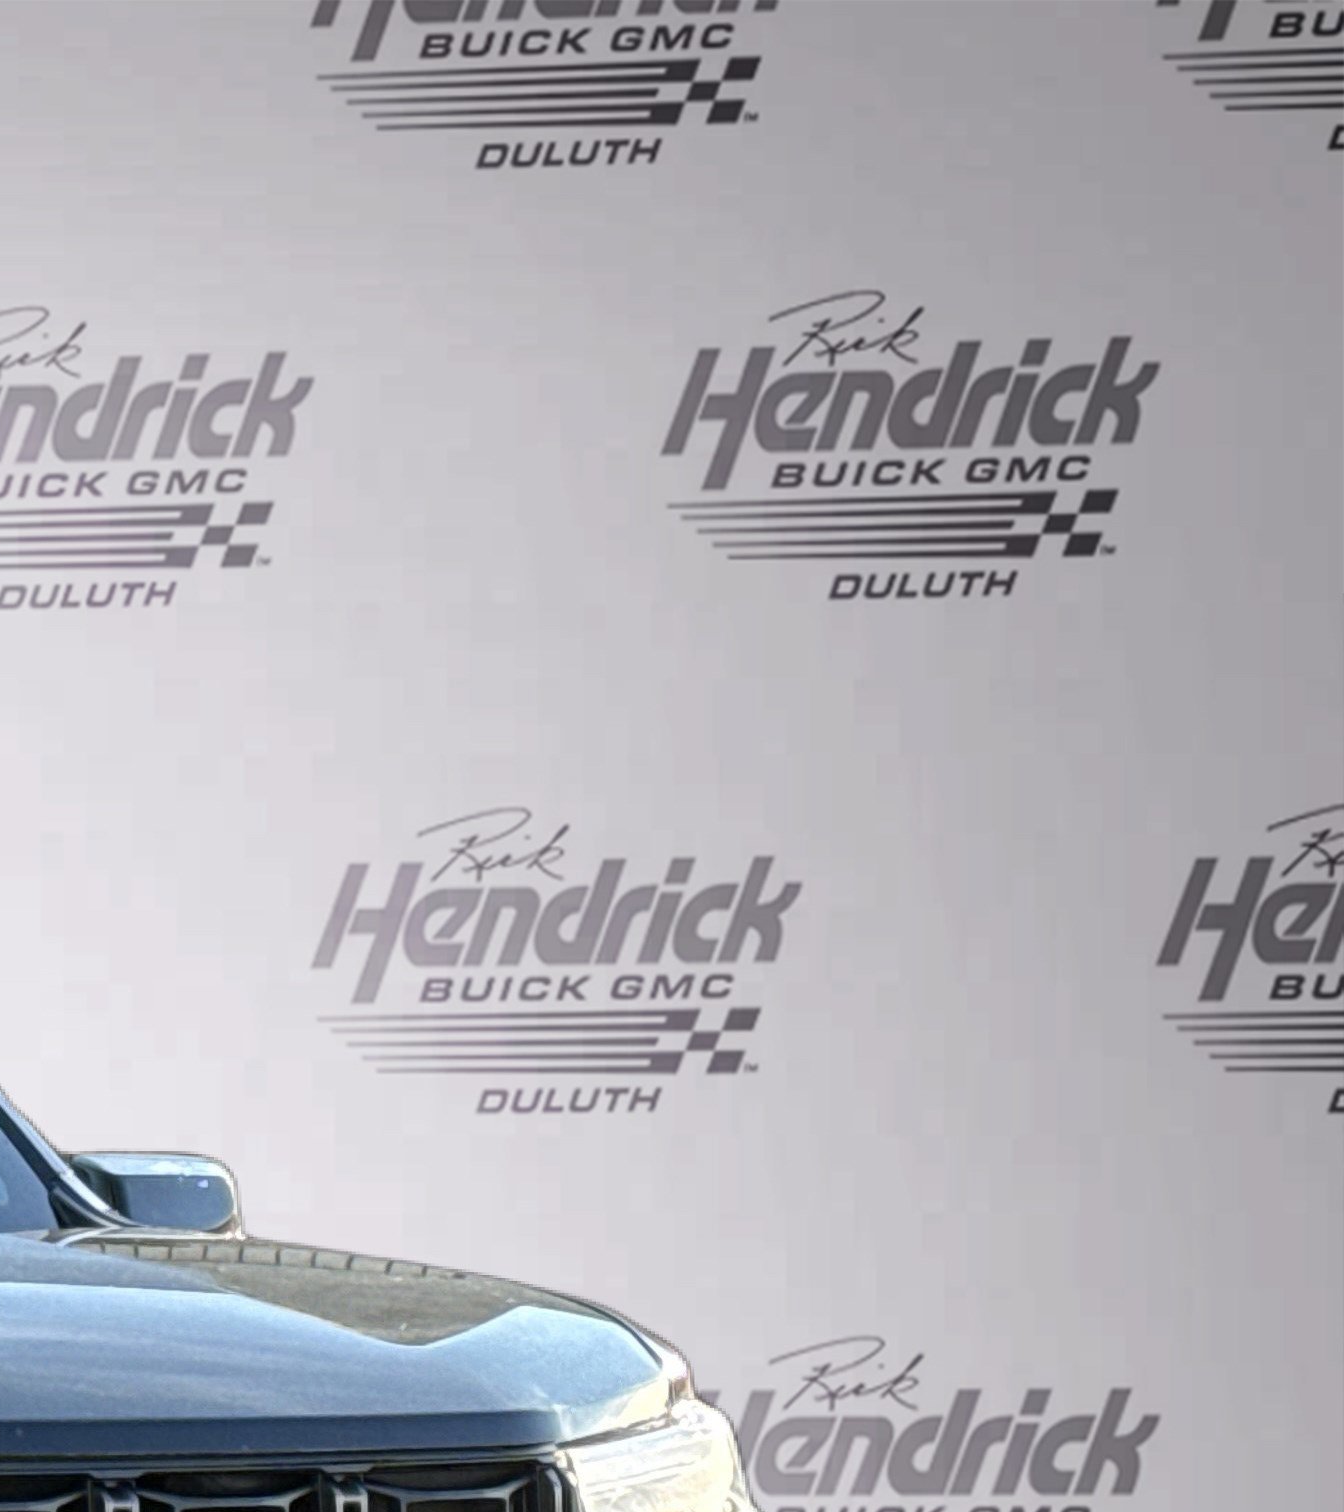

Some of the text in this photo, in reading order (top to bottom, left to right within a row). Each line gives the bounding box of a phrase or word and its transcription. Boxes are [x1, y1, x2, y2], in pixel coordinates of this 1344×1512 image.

[420, 28, 591, 58] BUICK
[611, 23, 734, 52] GMC
[476, 138, 662, 169] DULUTH
[660, 336, 1162, 491] Hendrick
[127, 468, 247, 495] GMC
[772, 455, 1091, 488] BUICK GMC
[829, 570, 1018, 600] DULUTH
[313, 855, 803, 1003] Hendrick
[420, 974, 734, 1002] BUICK GMC
[477, 1087, 662, 1113] DULUTH
